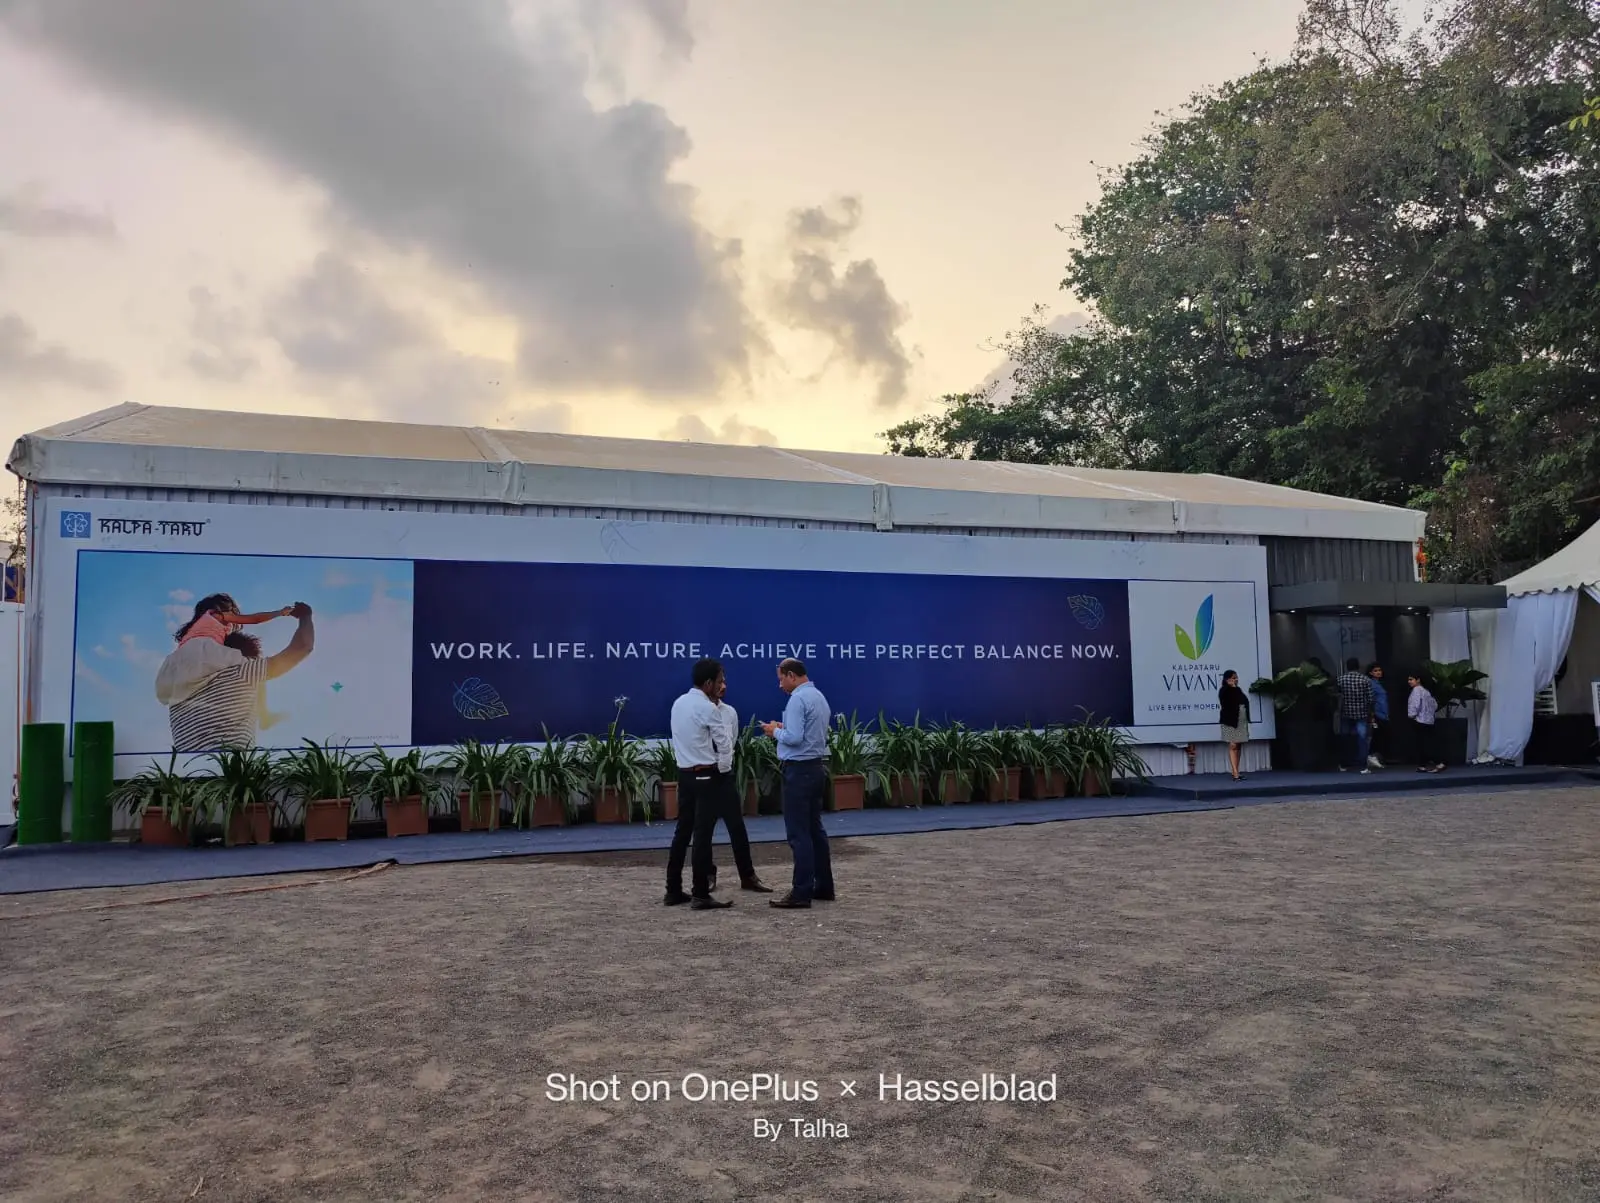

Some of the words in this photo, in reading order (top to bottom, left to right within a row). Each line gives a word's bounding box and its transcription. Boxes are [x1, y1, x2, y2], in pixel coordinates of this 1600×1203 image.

[430, 642, 521, 659] WORK.
[532, 642, 594, 659] LIFE.
[606, 642, 709, 659] NATURE.
[719, 643, 817, 659] ACHIEVE
[826, 644, 866, 659] THE
[875, 644, 965, 659] PERFECT
[974, 645, 1064, 659] BALANCE
[1071, 645, 1120, 659] NOW.
[1148, 704, 1165, 712] LIVE
